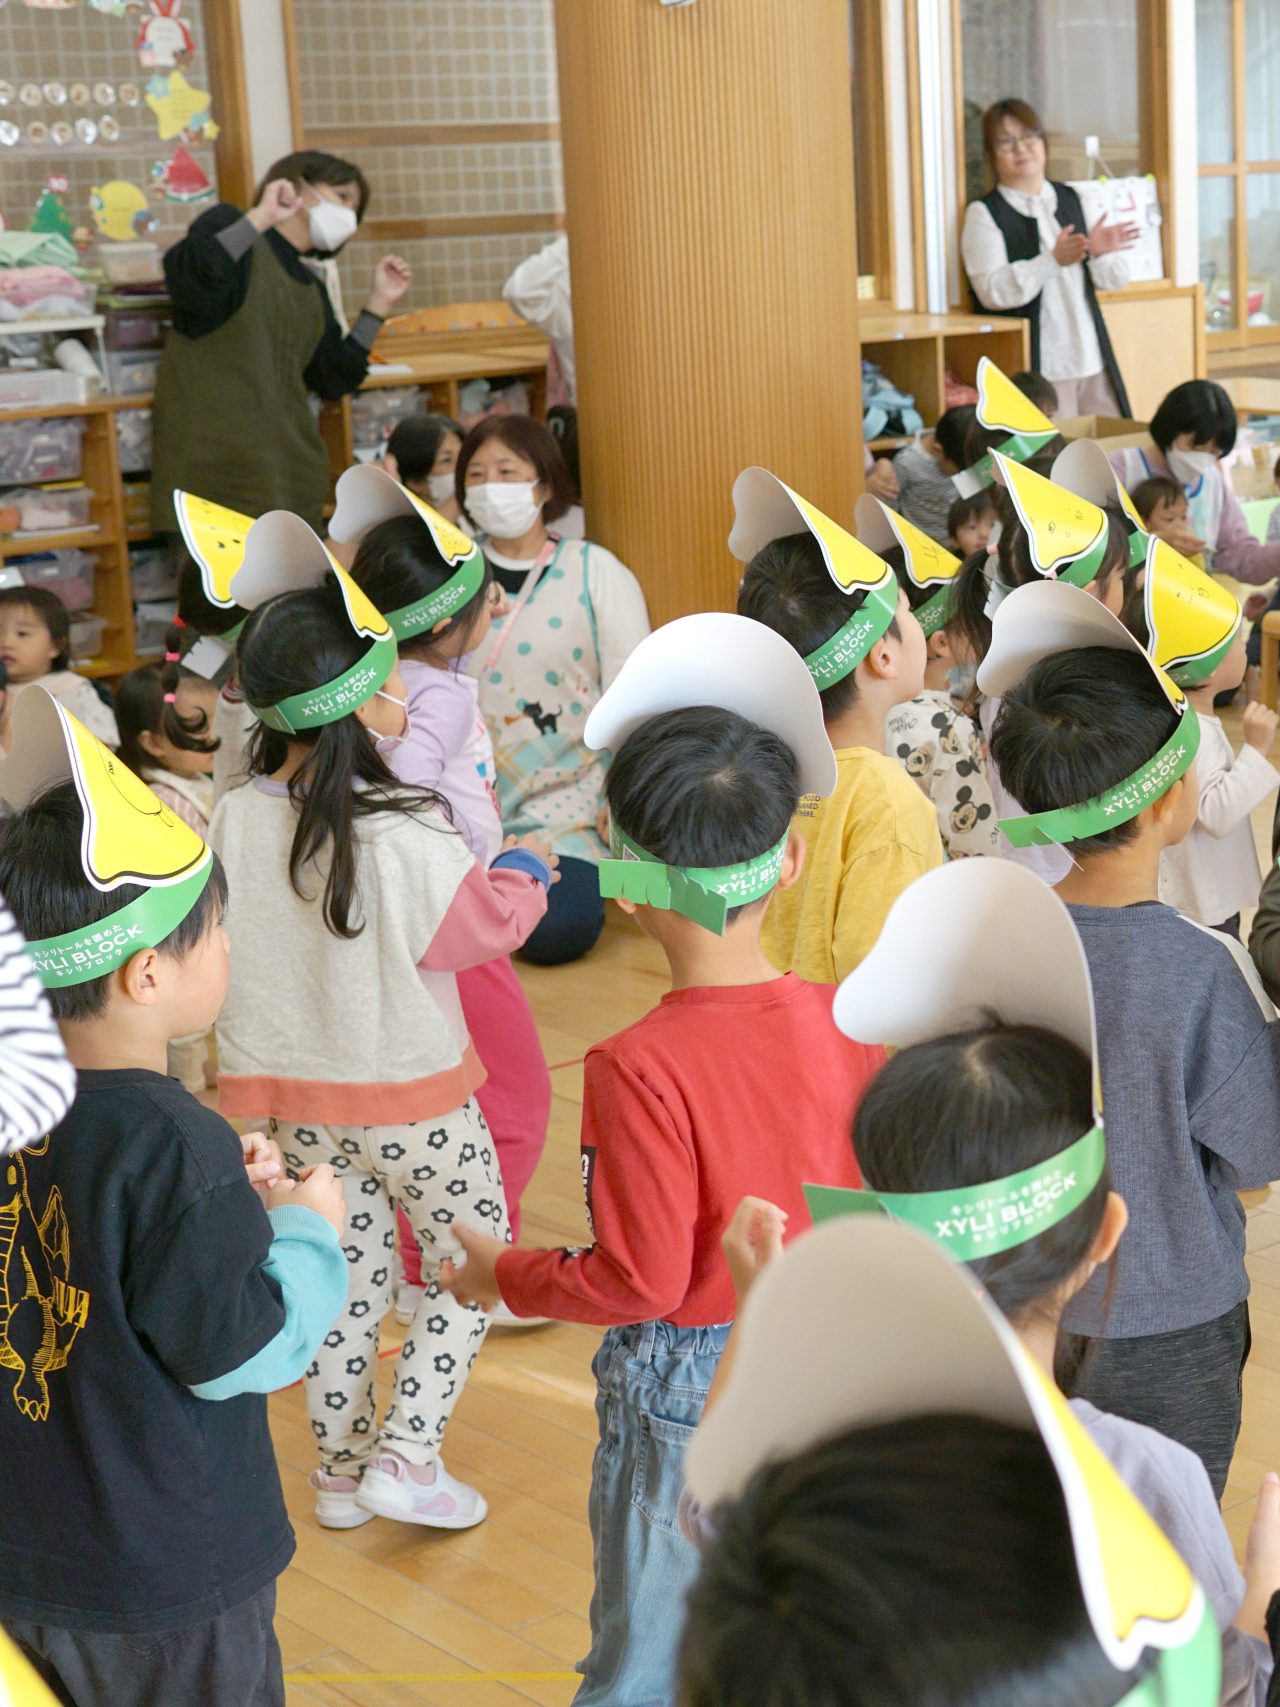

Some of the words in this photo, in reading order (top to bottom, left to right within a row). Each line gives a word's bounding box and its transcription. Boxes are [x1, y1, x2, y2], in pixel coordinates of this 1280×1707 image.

[402, 612, 428, 628] XYLI
[429, 584, 466, 614] BLOCK
[811, 661, 834, 677] YLI
[834, 620, 874, 663] BLOCK
[302, 699, 334, 717] XYLI
[336, 667, 378, 704] BLOCK
[1103, 790, 1140, 816] XYLI
[1141, 744, 1187, 793] BLOCK
[716, 876, 756, 895] XYLI
[31, 956, 70, 972] XYLI
[71, 924, 143, 964] BLOCK
[934, 1212, 995, 1238] XYLI
[1000, 1171, 1078, 1224] BLOCK
